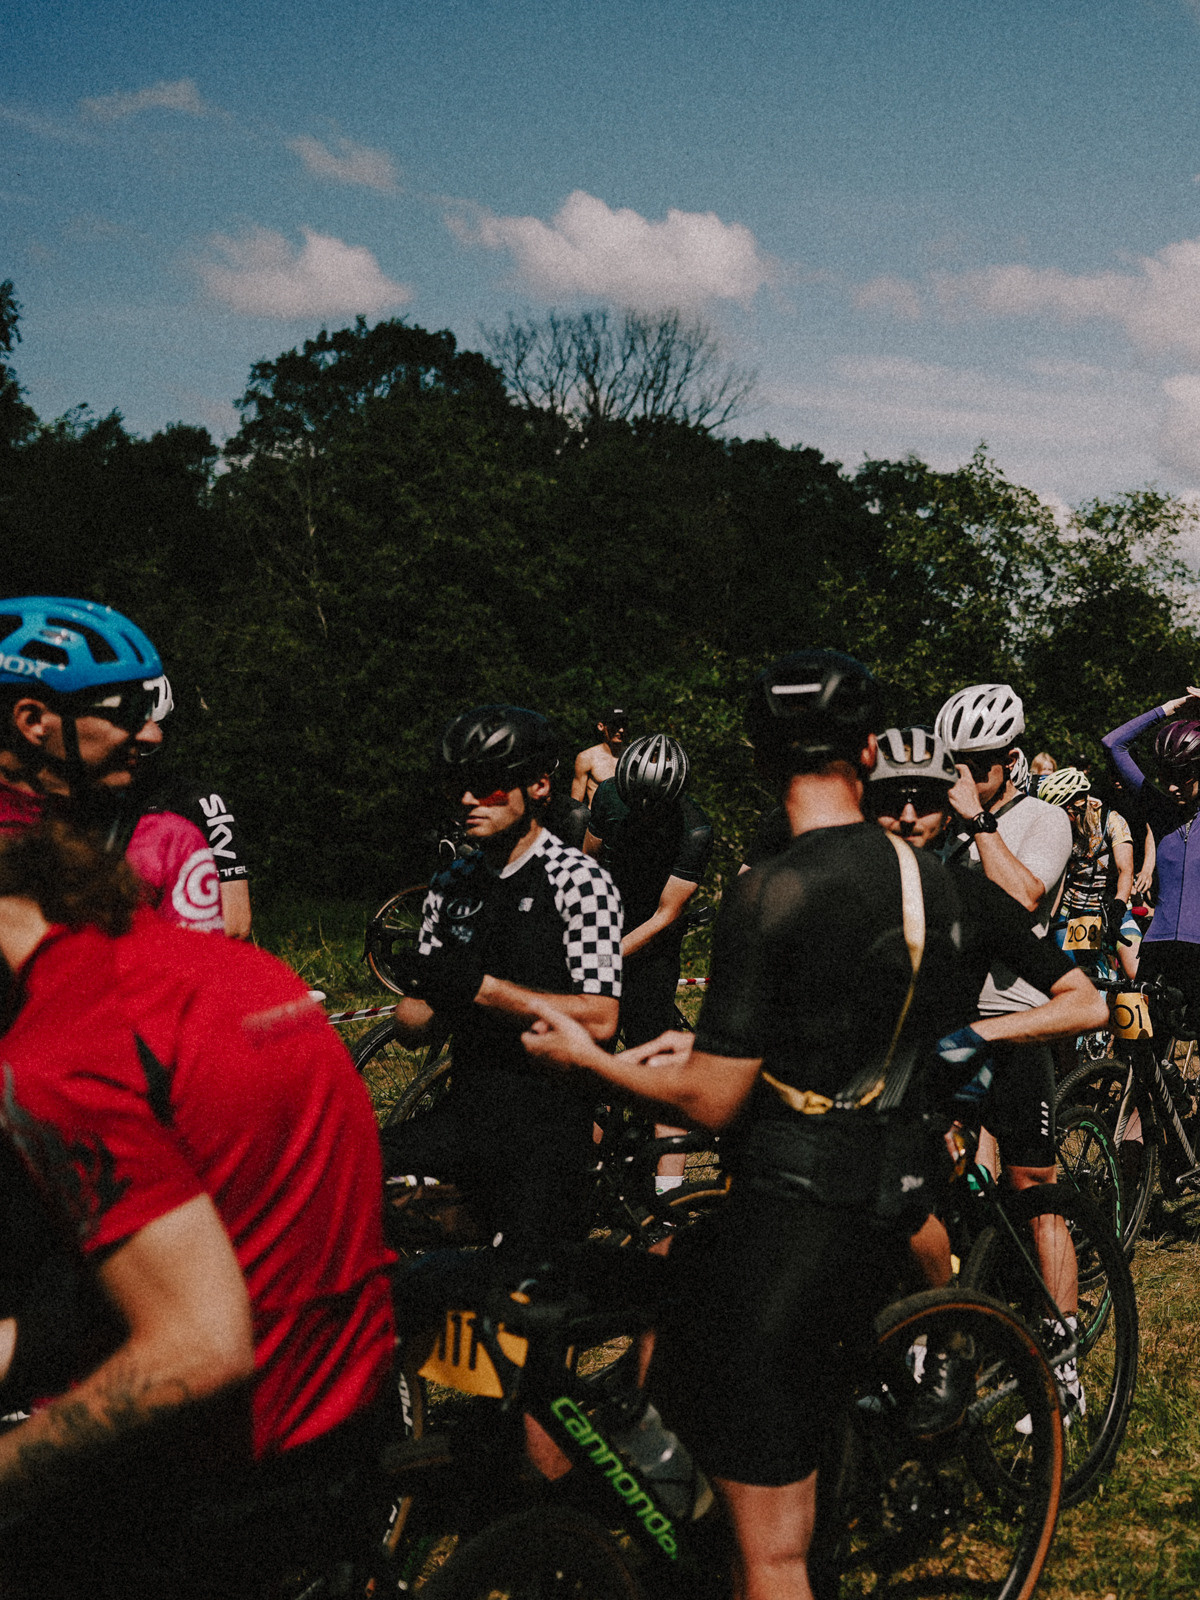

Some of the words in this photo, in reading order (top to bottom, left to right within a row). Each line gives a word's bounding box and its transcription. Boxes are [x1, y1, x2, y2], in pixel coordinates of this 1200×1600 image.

[0, 652, 53, 678] OX
[1068, 923, 1098, 943] 203
[1040, 1101, 1049, 1136] MAAP
